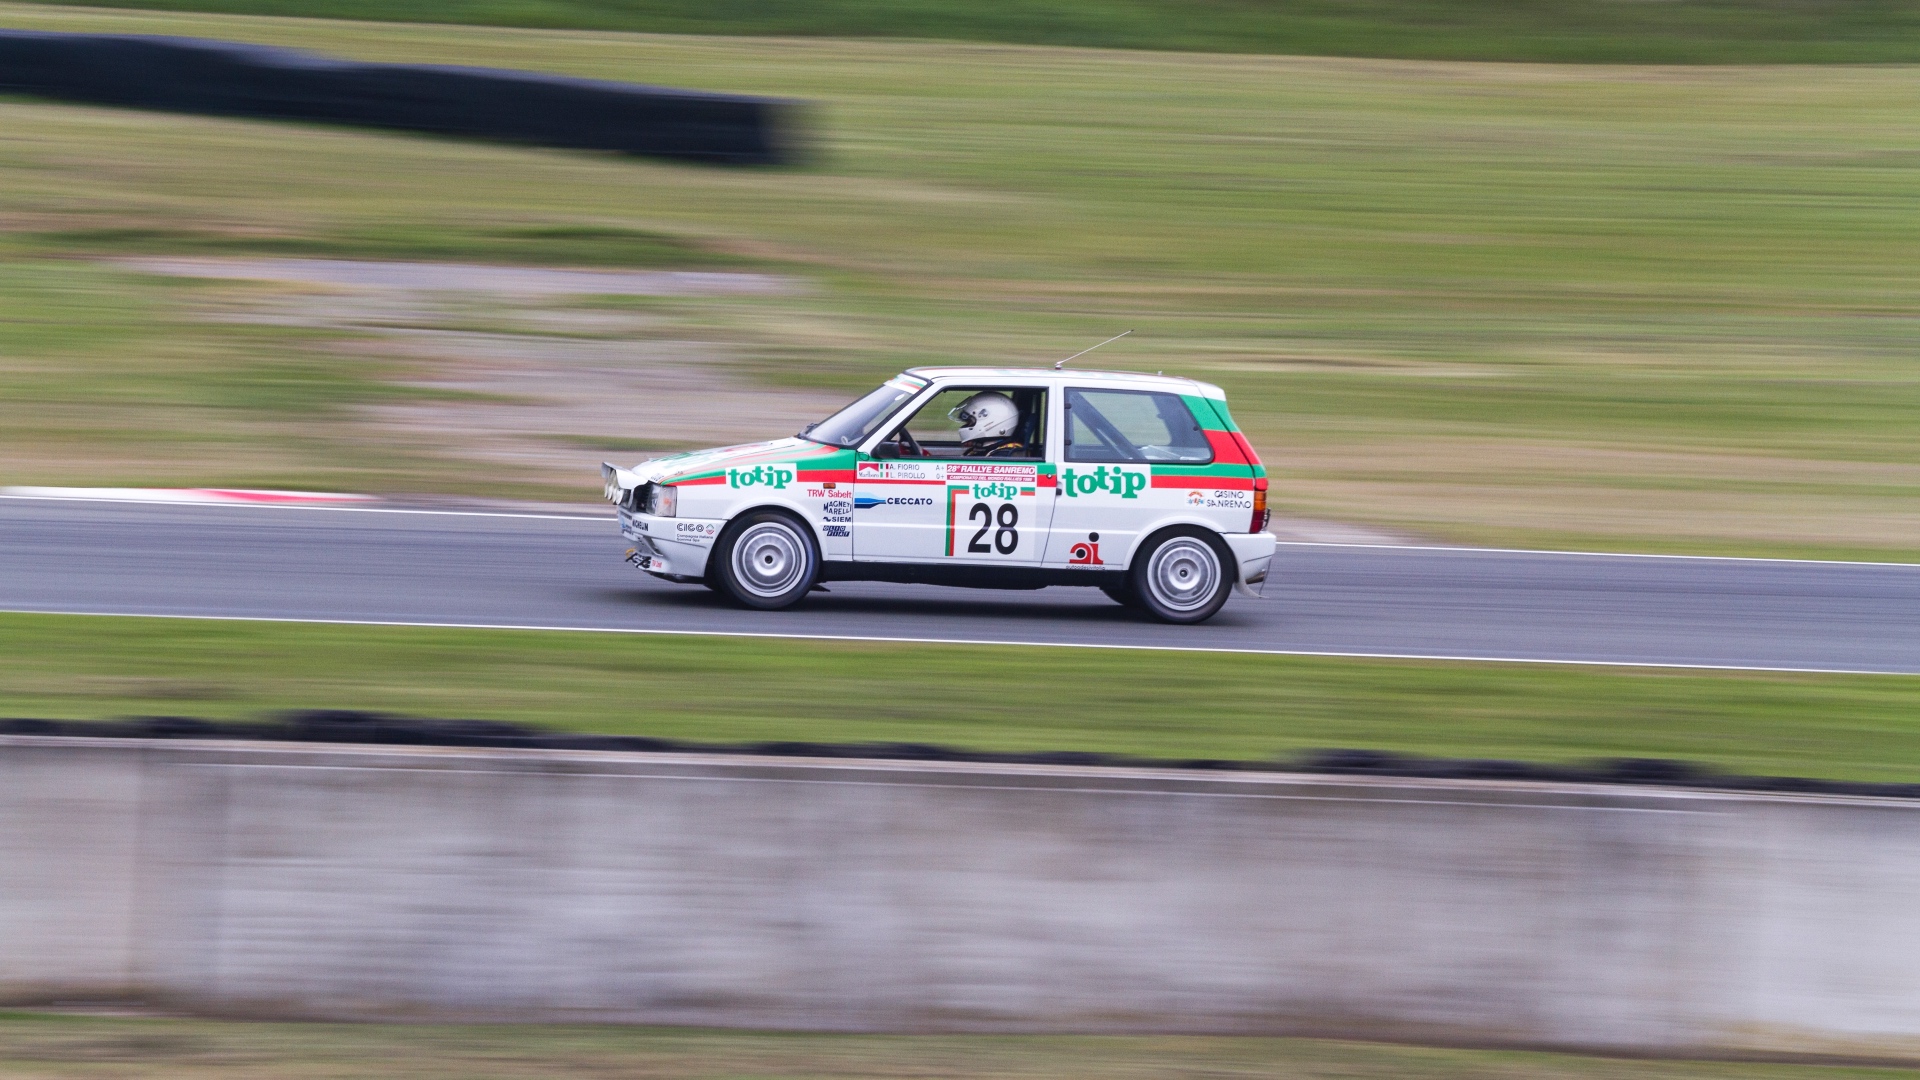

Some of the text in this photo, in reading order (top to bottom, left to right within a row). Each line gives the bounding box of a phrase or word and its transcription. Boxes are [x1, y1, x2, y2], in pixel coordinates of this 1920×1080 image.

[993, 466, 1035, 475] SANREMO
[728, 466, 793, 490] totip
[1062, 466, 1146, 499] totip
[807, 489, 852, 498] TRW Sabelt
[973, 482, 1018, 500] totip
[1214, 490, 1245, 499] CASINO
[887, 497, 933, 505] CECCATO
[1206, 499, 1252, 509] SANREMO
[967, 502, 1019, 555] 28
